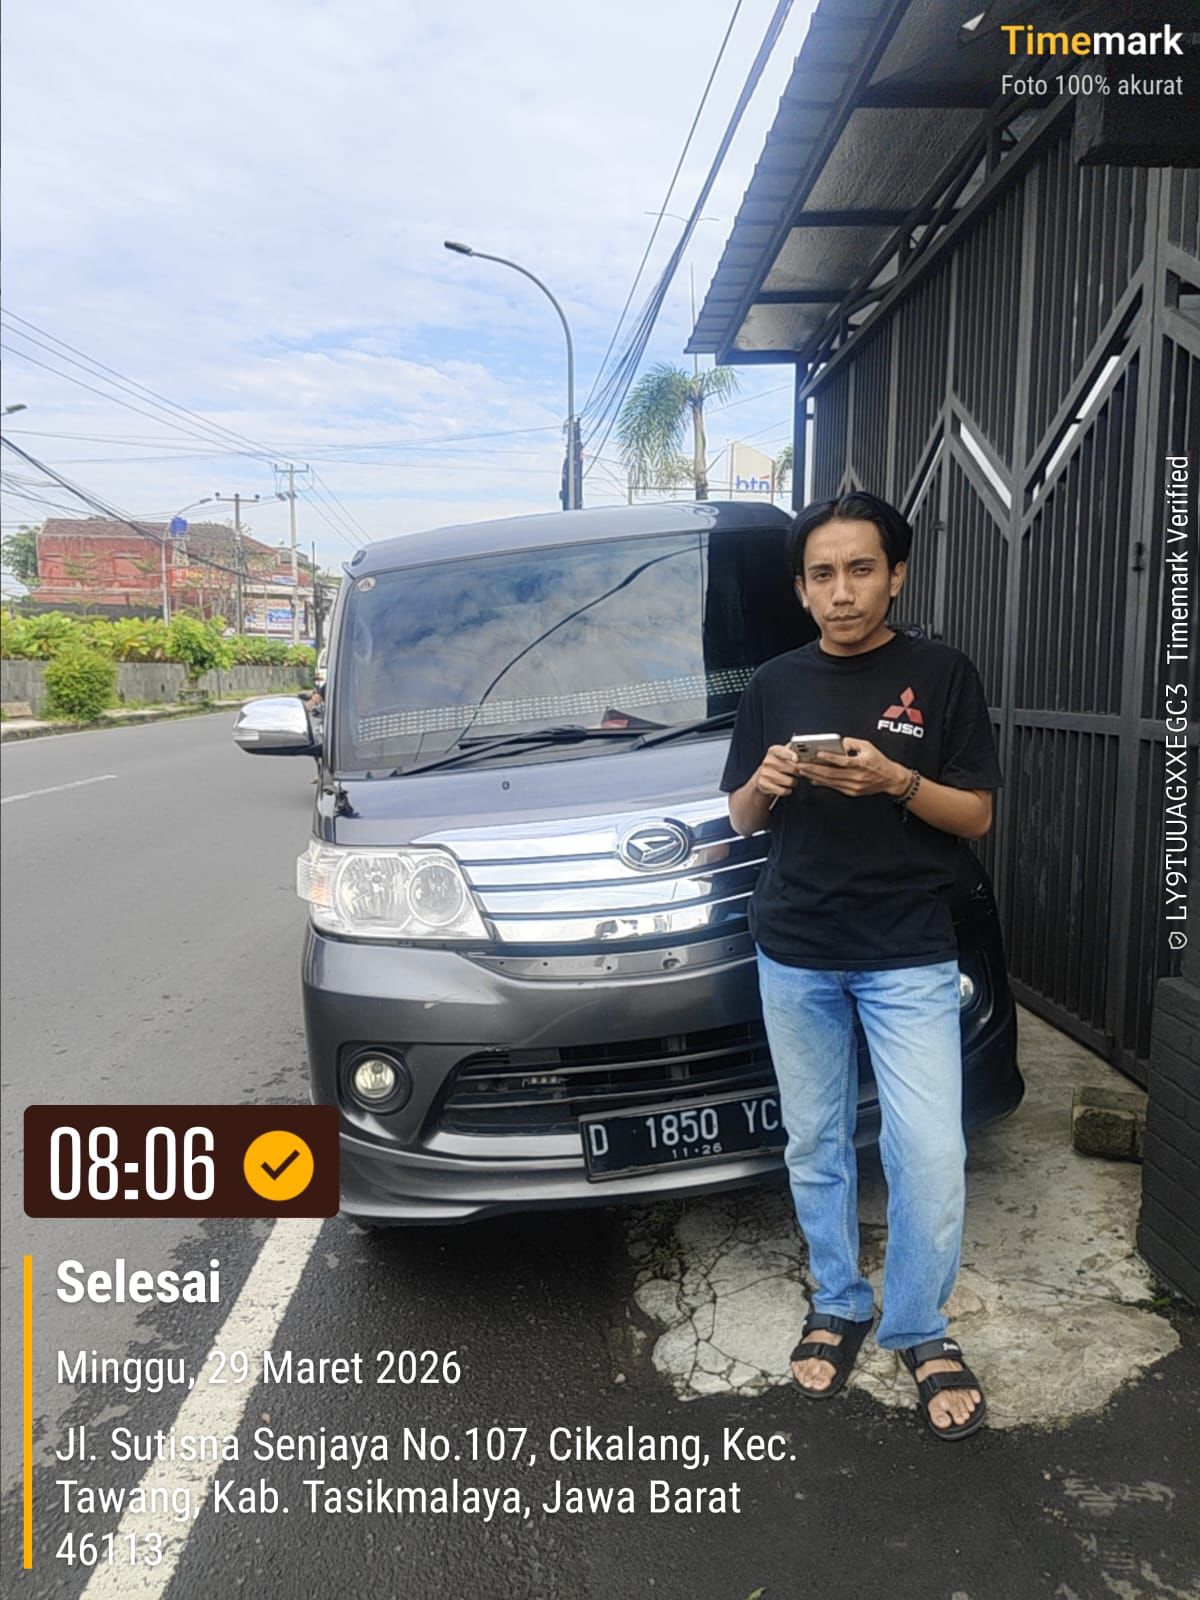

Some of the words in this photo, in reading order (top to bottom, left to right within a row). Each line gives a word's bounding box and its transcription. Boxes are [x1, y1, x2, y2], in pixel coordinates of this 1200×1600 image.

[877, 719, 924, 738] FUSO
[589, 1123, 609, 1156] D
[646, 1108, 719, 1149] 1850
